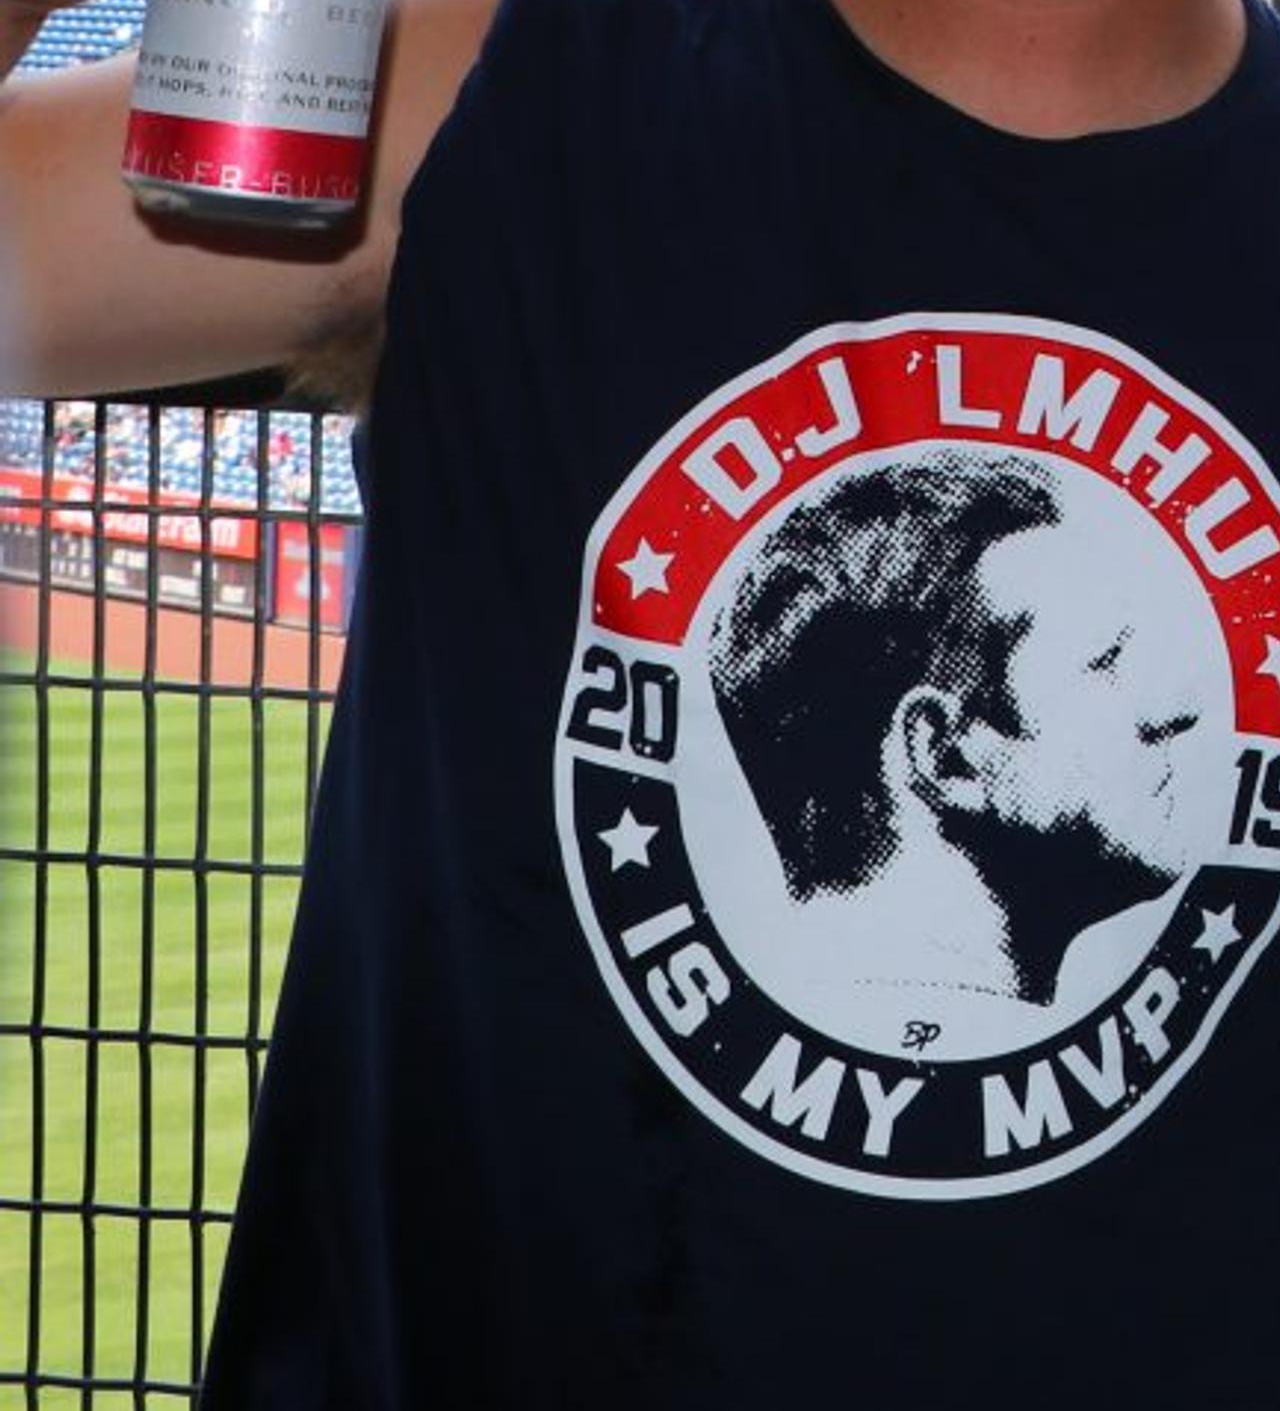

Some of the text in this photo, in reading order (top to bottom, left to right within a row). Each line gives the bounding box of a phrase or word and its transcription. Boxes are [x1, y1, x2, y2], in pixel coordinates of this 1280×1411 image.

[568, 647, 679, 763] 20
[621, 902, 1182, 1159] IS MY MVP
